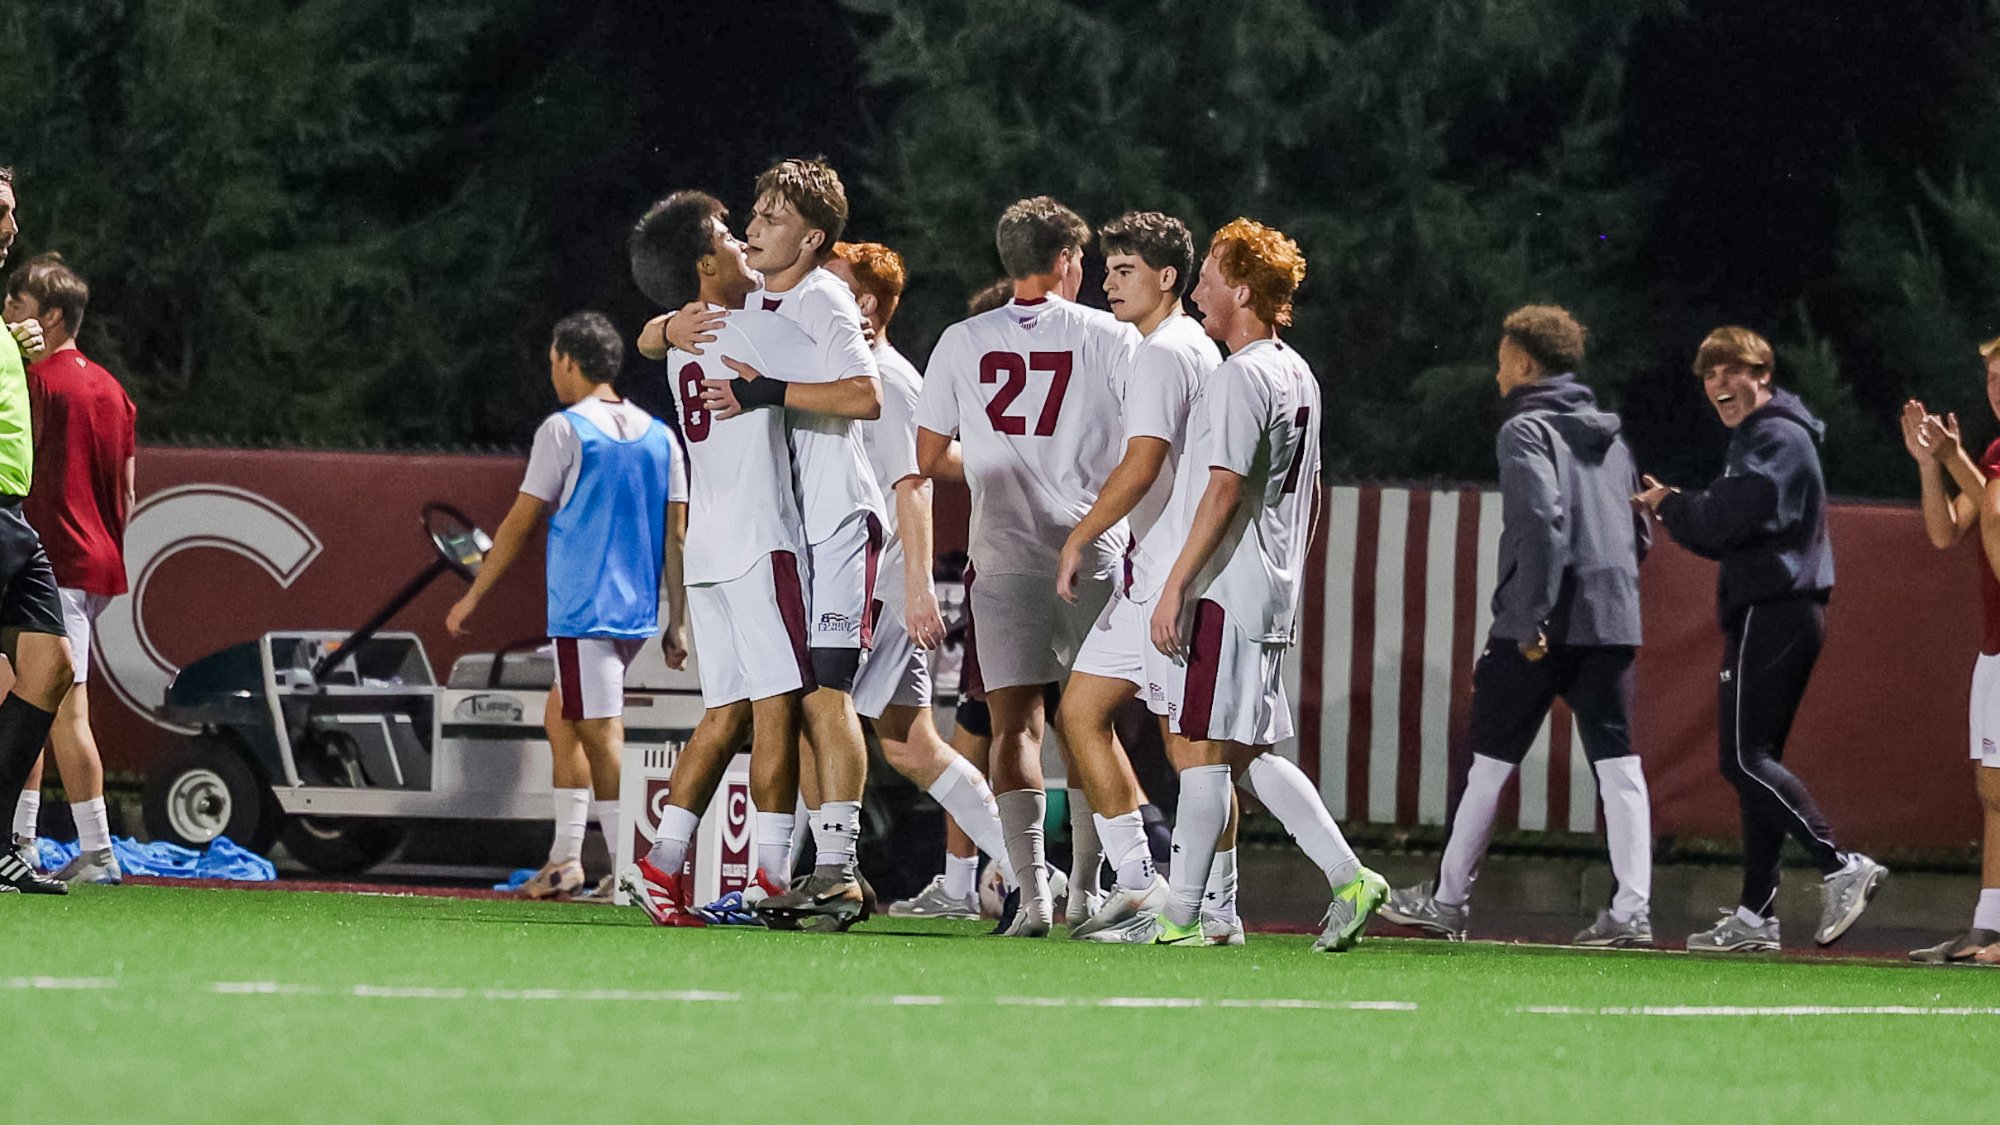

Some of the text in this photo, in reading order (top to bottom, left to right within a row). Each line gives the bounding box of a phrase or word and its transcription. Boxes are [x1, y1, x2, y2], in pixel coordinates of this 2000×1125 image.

[679, 361, 711, 443] 8
[979, 350, 1073, 437] 27
[91, 483, 324, 736] C
[730, 792, 746, 826] C
